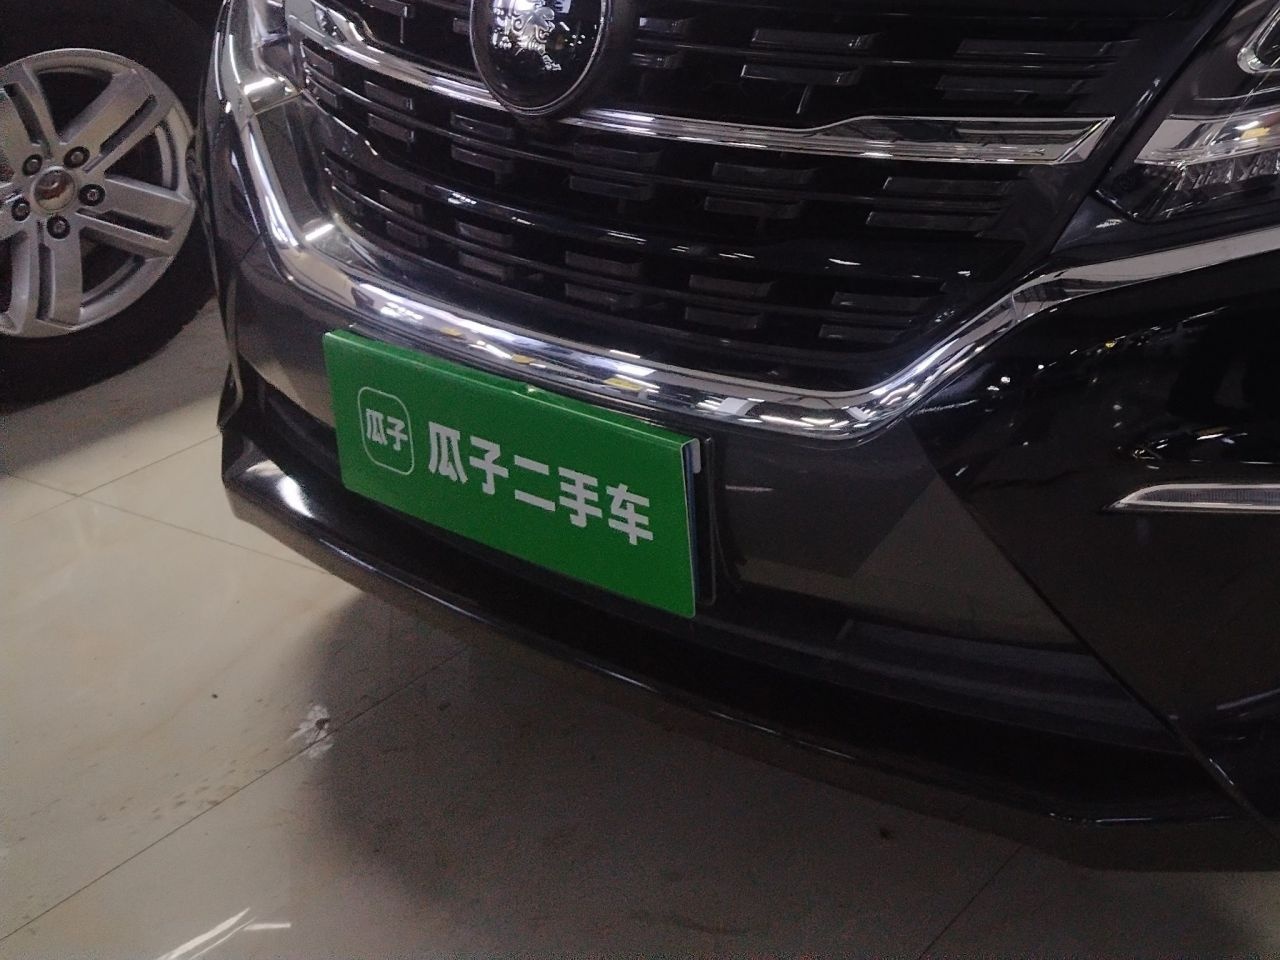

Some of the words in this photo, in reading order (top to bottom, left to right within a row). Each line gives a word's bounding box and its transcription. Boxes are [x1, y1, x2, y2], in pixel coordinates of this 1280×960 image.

[365, 408, 408, 451] 瓜子
[428, 421, 654, 546] 瓜子二手车
